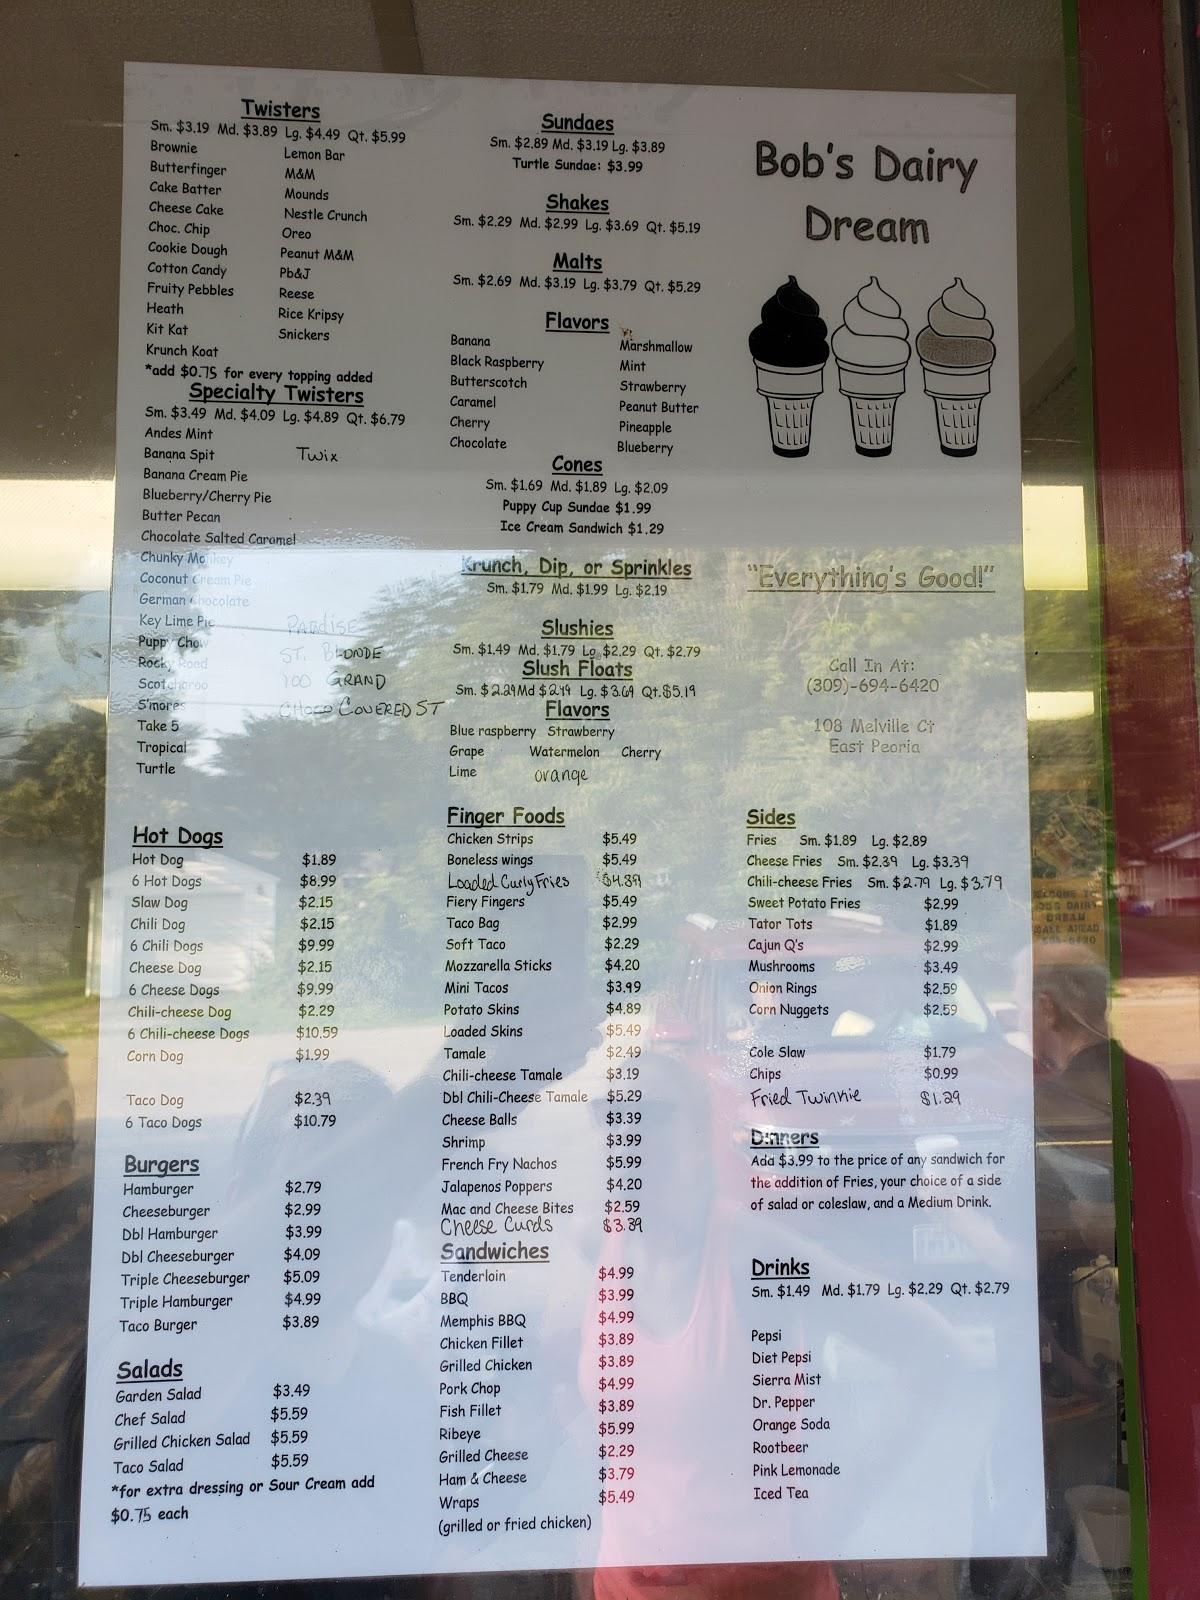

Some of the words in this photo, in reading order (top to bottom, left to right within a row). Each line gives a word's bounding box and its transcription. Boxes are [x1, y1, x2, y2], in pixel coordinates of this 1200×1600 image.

[240, 98, 321, 124] Twisters
[541, 112, 614, 132] Sundaes
[150, 119, 173, 133] Sm.
[175, 119, 210, 135] $3.19
[217, 122, 239, 136] Md.
[242, 122, 278, 139] $3.89
[285, 125, 302, 142] Lg.
[305, 125, 341, 142] $4.49
[347, 129, 368, 144] Qt.
[371, 128, 406, 145] $5.99
[150, 139, 198, 154] Brownie
[284, 146, 322, 161] Lemon
[325, 148, 346, 162] Bar
[150, 160, 227, 179] Butterfinger
[284, 167, 316, 181] M&M
[511, 156, 550, 170] Turtle
[554, 158, 601, 171] Sundae:
[607, 159, 644, 174] $3.99
[756, 140, 853, 179] Bob's
[874, 144, 979, 194] Dairy
[149, 180, 179, 194] Cake
[182, 182, 222, 196] Batter
[284, 187, 329, 201] Mounds
[148, 200, 192, 215] Cheese
[195, 203, 224, 216] Cake
[545, 192, 610, 212] Shakes
[284, 207, 324, 221] Nestle
[326, 209, 368, 222] Crunch
[148, 220, 181, 234] Choc.
[184, 222, 210, 239] Chip
[281, 227, 312, 240] Oreo
[453, 214, 475, 227] Sm.
[477, 213, 513, 229] $2.29
[519, 216, 541, 229] Md.
[544, 215, 579, 231] $2.99
[585, 218, 602, 234] Lg.
[605, 218, 639, 233] $3.69
[646, 221, 666, 235] Qt.
[669, 221, 701, 236] $5.19
[805, 204, 930, 245] Dream
[147, 240, 188, 254] Cookie
[191, 242, 228, 259] Dough
[280, 246, 320, 260] Peanut
[323, 248, 355, 262] M&M
[552, 251, 603, 271] Malts
[146, 301, 184, 315] Heath
[545, 311, 610, 331] Flavors
[278, 327, 330, 341] Snickers
[450, 333, 491, 347] Banana
[619, 338, 693, 353] Marshmallow
[223, 366, 244, 380] for
[248, 370, 283, 384] every
[287, 369, 332, 385] topping
[336, 371, 373, 383] added
[450, 374, 528, 389] Butterscotch
[189, 382, 276, 405] Specialty
[283, 384, 364, 403] Twisters
[619, 380, 687, 397] Strawberry
[144, 426, 182, 439] Andes
[185, 427, 214, 440] Mint
[619, 420, 673, 437] Pineapple
[295, 446, 339, 463] Twix
[551, 454, 603, 473] Cones
[142, 508, 183, 522] Butter
[186, 510, 221, 523] Pecan
[502, 498, 537, 516] Puppy
[541, 500, 563, 516] Cup
[567, 500, 611, 514] Sundae
[615, 500, 652, 516] $1.99
[140, 529, 201, 543] Chocolate
[204, 531, 245, 545] Salted
[248, 532, 296, 546] Caramel
[461, 556, 529, 574] Krunch,
[539, 557, 574, 579] Dip,
[583, 563, 602, 575] or
[611, 559, 692, 580] Sprinkles
[541, 617, 614, 637] Slushies
[522, 660, 570, 676] Slush
[579, 660, 633, 677] Floats
[829, 657, 857, 673] Call
[864, 658, 883, 673] In
[806, 678, 940, 696] (309)-694-6420
[136, 719, 168, 732] Take
[170, 719, 180, 733] 5
[816, 718, 843, 733] 108
[850, 718, 910, 733] Melville
[917, 719, 935, 734] Ct
[449, 744, 485, 761] Grape
[529, 744, 600, 758] Watermelon
[621, 745, 662, 762] Cherry
[829, 738, 865, 754] East
[871, 739, 919, 753] Peoria
[135, 761, 176, 775] Turtle
[449, 765, 478, 778] Lime
[447, 805, 505, 825] Finger
[513, 805, 565, 825] Foods
[746, 807, 796, 826] Sides
[132, 825, 170, 844] Hot
[178, 826, 224, 846] Dogs
[447, 832, 493, 845] Chicken
[496, 832, 534, 848] Strips
[602, 831, 637, 847] $5.49
[132, 852, 157, 866] Hot
[160, 853, 184, 869] Dog
[301, 852, 337, 869] $1.89
[444, 958, 511, 972] Mozzarella
[513, 958, 553, 972] Sticks
[604, 957, 641, 974] $4.20
[748, 959, 816, 973] Mushrooms
[923, 959, 959, 976] $3.49
[748, 981, 783, 994] Onion
[786, 981, 818, 998] Rings
[922, 980, 958, 998] $2.59
[126, 1049, 156, 1062] Corn
[160, 1049, 184, 1065] Dog
[295, 1047, 330, 1064] $1.99
[441, 1135, 486, 1152] Shrimp
[605, 1132, 642, 1149] $3.99
[750, 1127, 820, 1146] Dinners
[124, 1154, 200, 1179] Burgers
[123, 1182, 195, 1199] Hamburger
[284, 1179, 322, 1197] $2.79
[440, 1218, 497, 1236] Cheese
[504, 1215, 553, 1233] Curds
[440, 1240, 550, 1261] Sandwiches
[751, 1256, 810, 1277] Drinks
[440, 1291, 469, 1308] BBQ
[598, 1287, 635, 1304] $3.99
[751, 1328, 782, 1346] Pepsi
[116, 1357, 183, 1380] Salads
[114, 1411, 147, 1427] Chef
[150, 1409, 186, 1425] Salad
[270, 1405, 309, 1424] $5.59
[439, 1426, 482, 1444] Ribeye
[598, 1420, 635, 1438] $5.99
[752, 1440, 809, 1454] Rootbeer
[753, 1485, 783, 1501] Iced
[785, 1486, 809, 1500] Tea
[157, 1505, 189, 1521] each
[438, 1517, 483, 1537] (grilled
[486, 1521, 501, 1532] or
[503, 1515, 537, 1532] fried
[540, 1513, 592, 1531] chicken)
